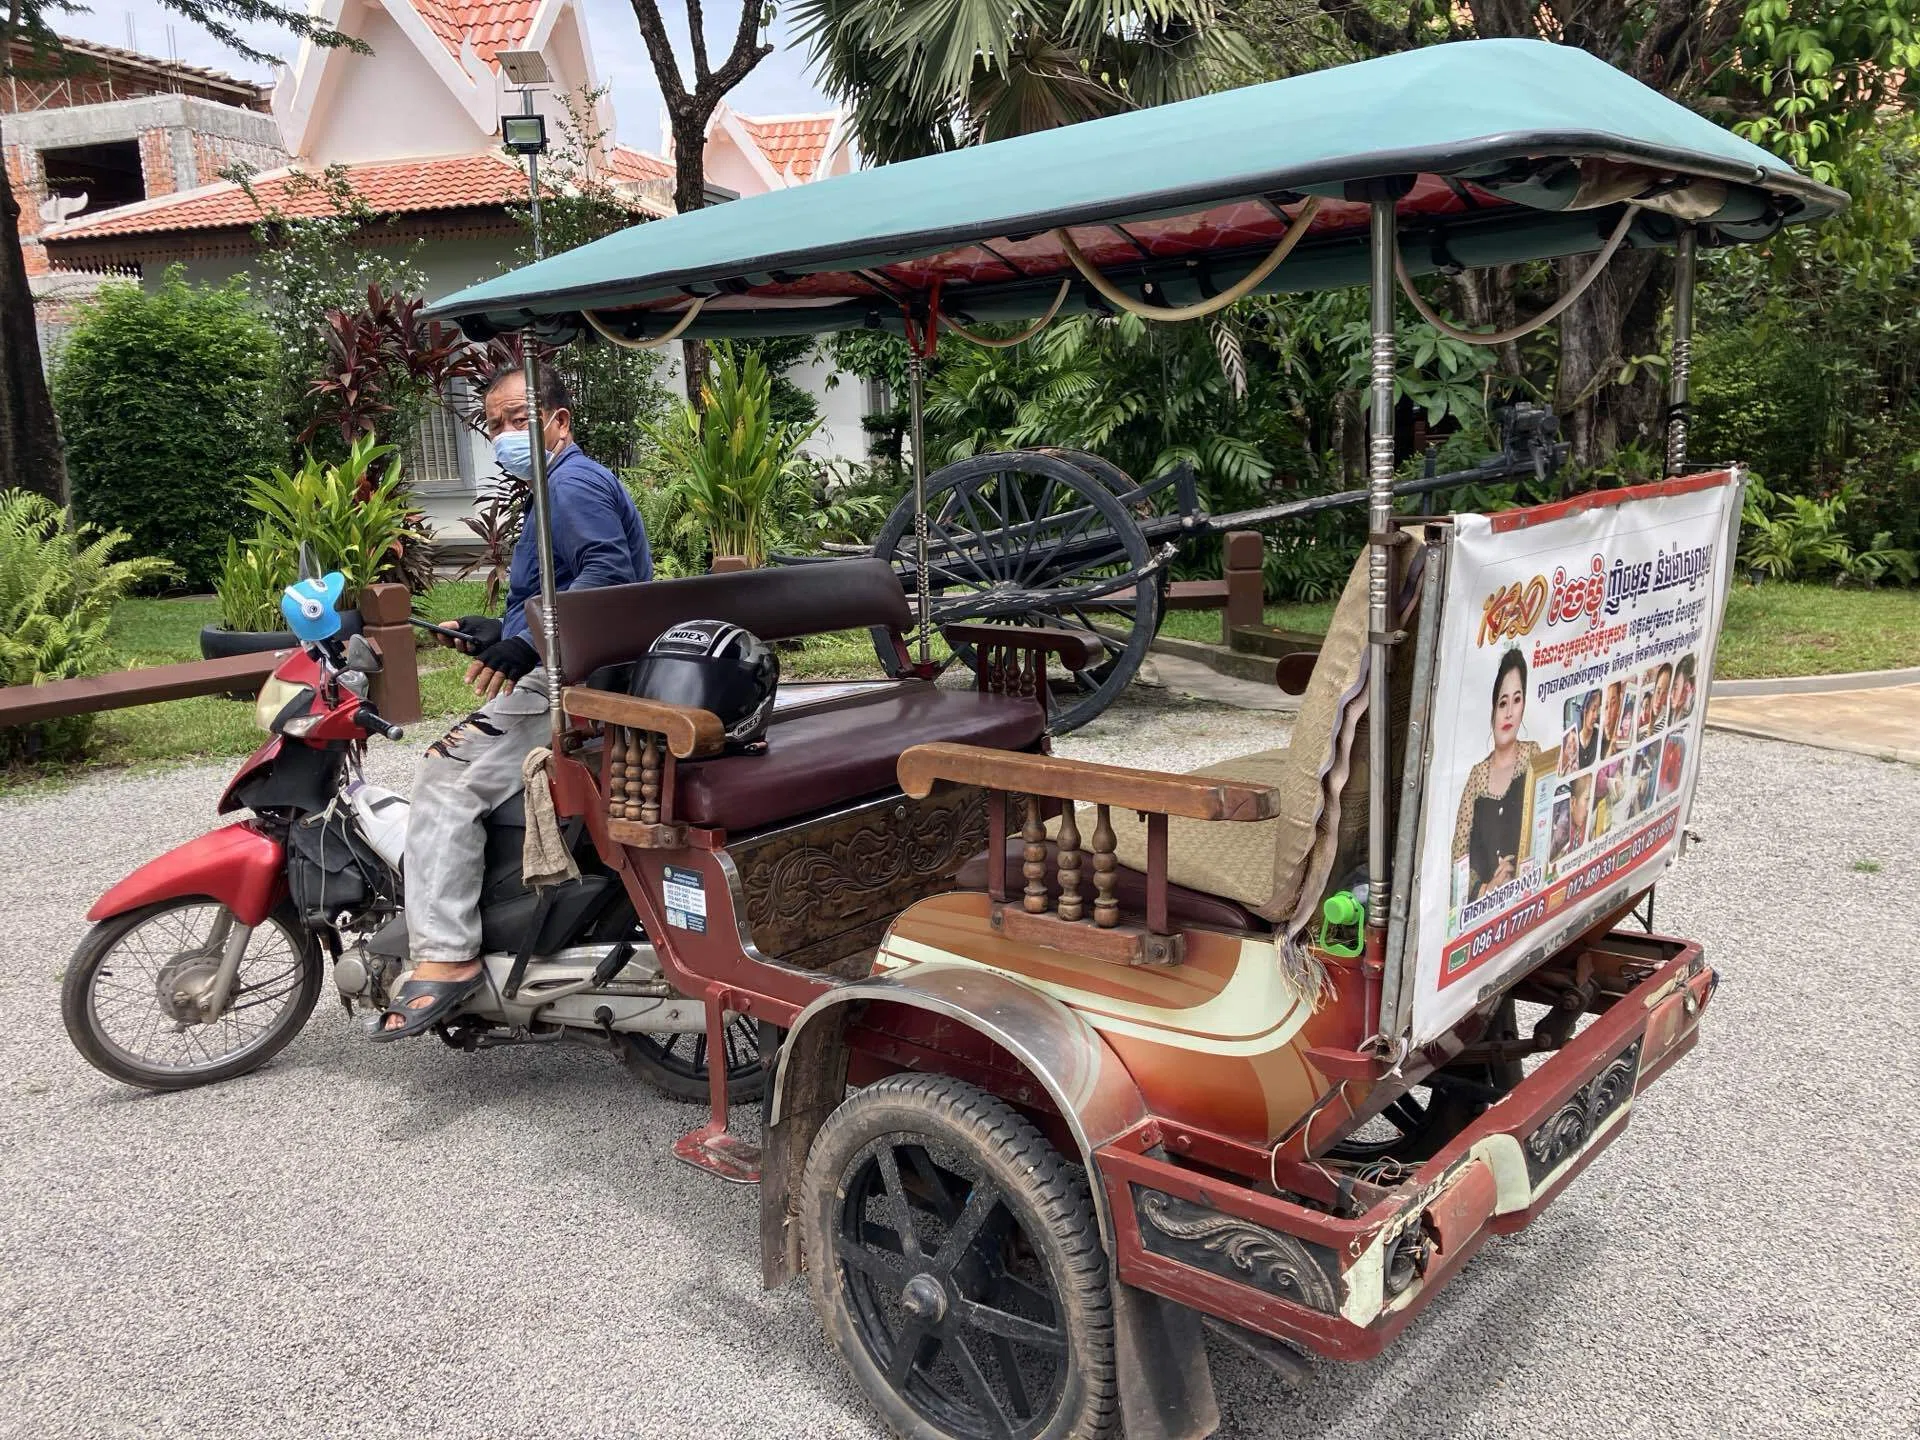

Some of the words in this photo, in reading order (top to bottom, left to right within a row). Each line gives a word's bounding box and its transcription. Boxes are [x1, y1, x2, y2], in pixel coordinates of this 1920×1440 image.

[668, 632, 704, 641] INDEX
[737, 715, 760, 734] INDEX
[1472, 929, 1493, 957] 096
[1494, 920, 1508, 942] 41
[1511, 904, 1535, 934] 7777
